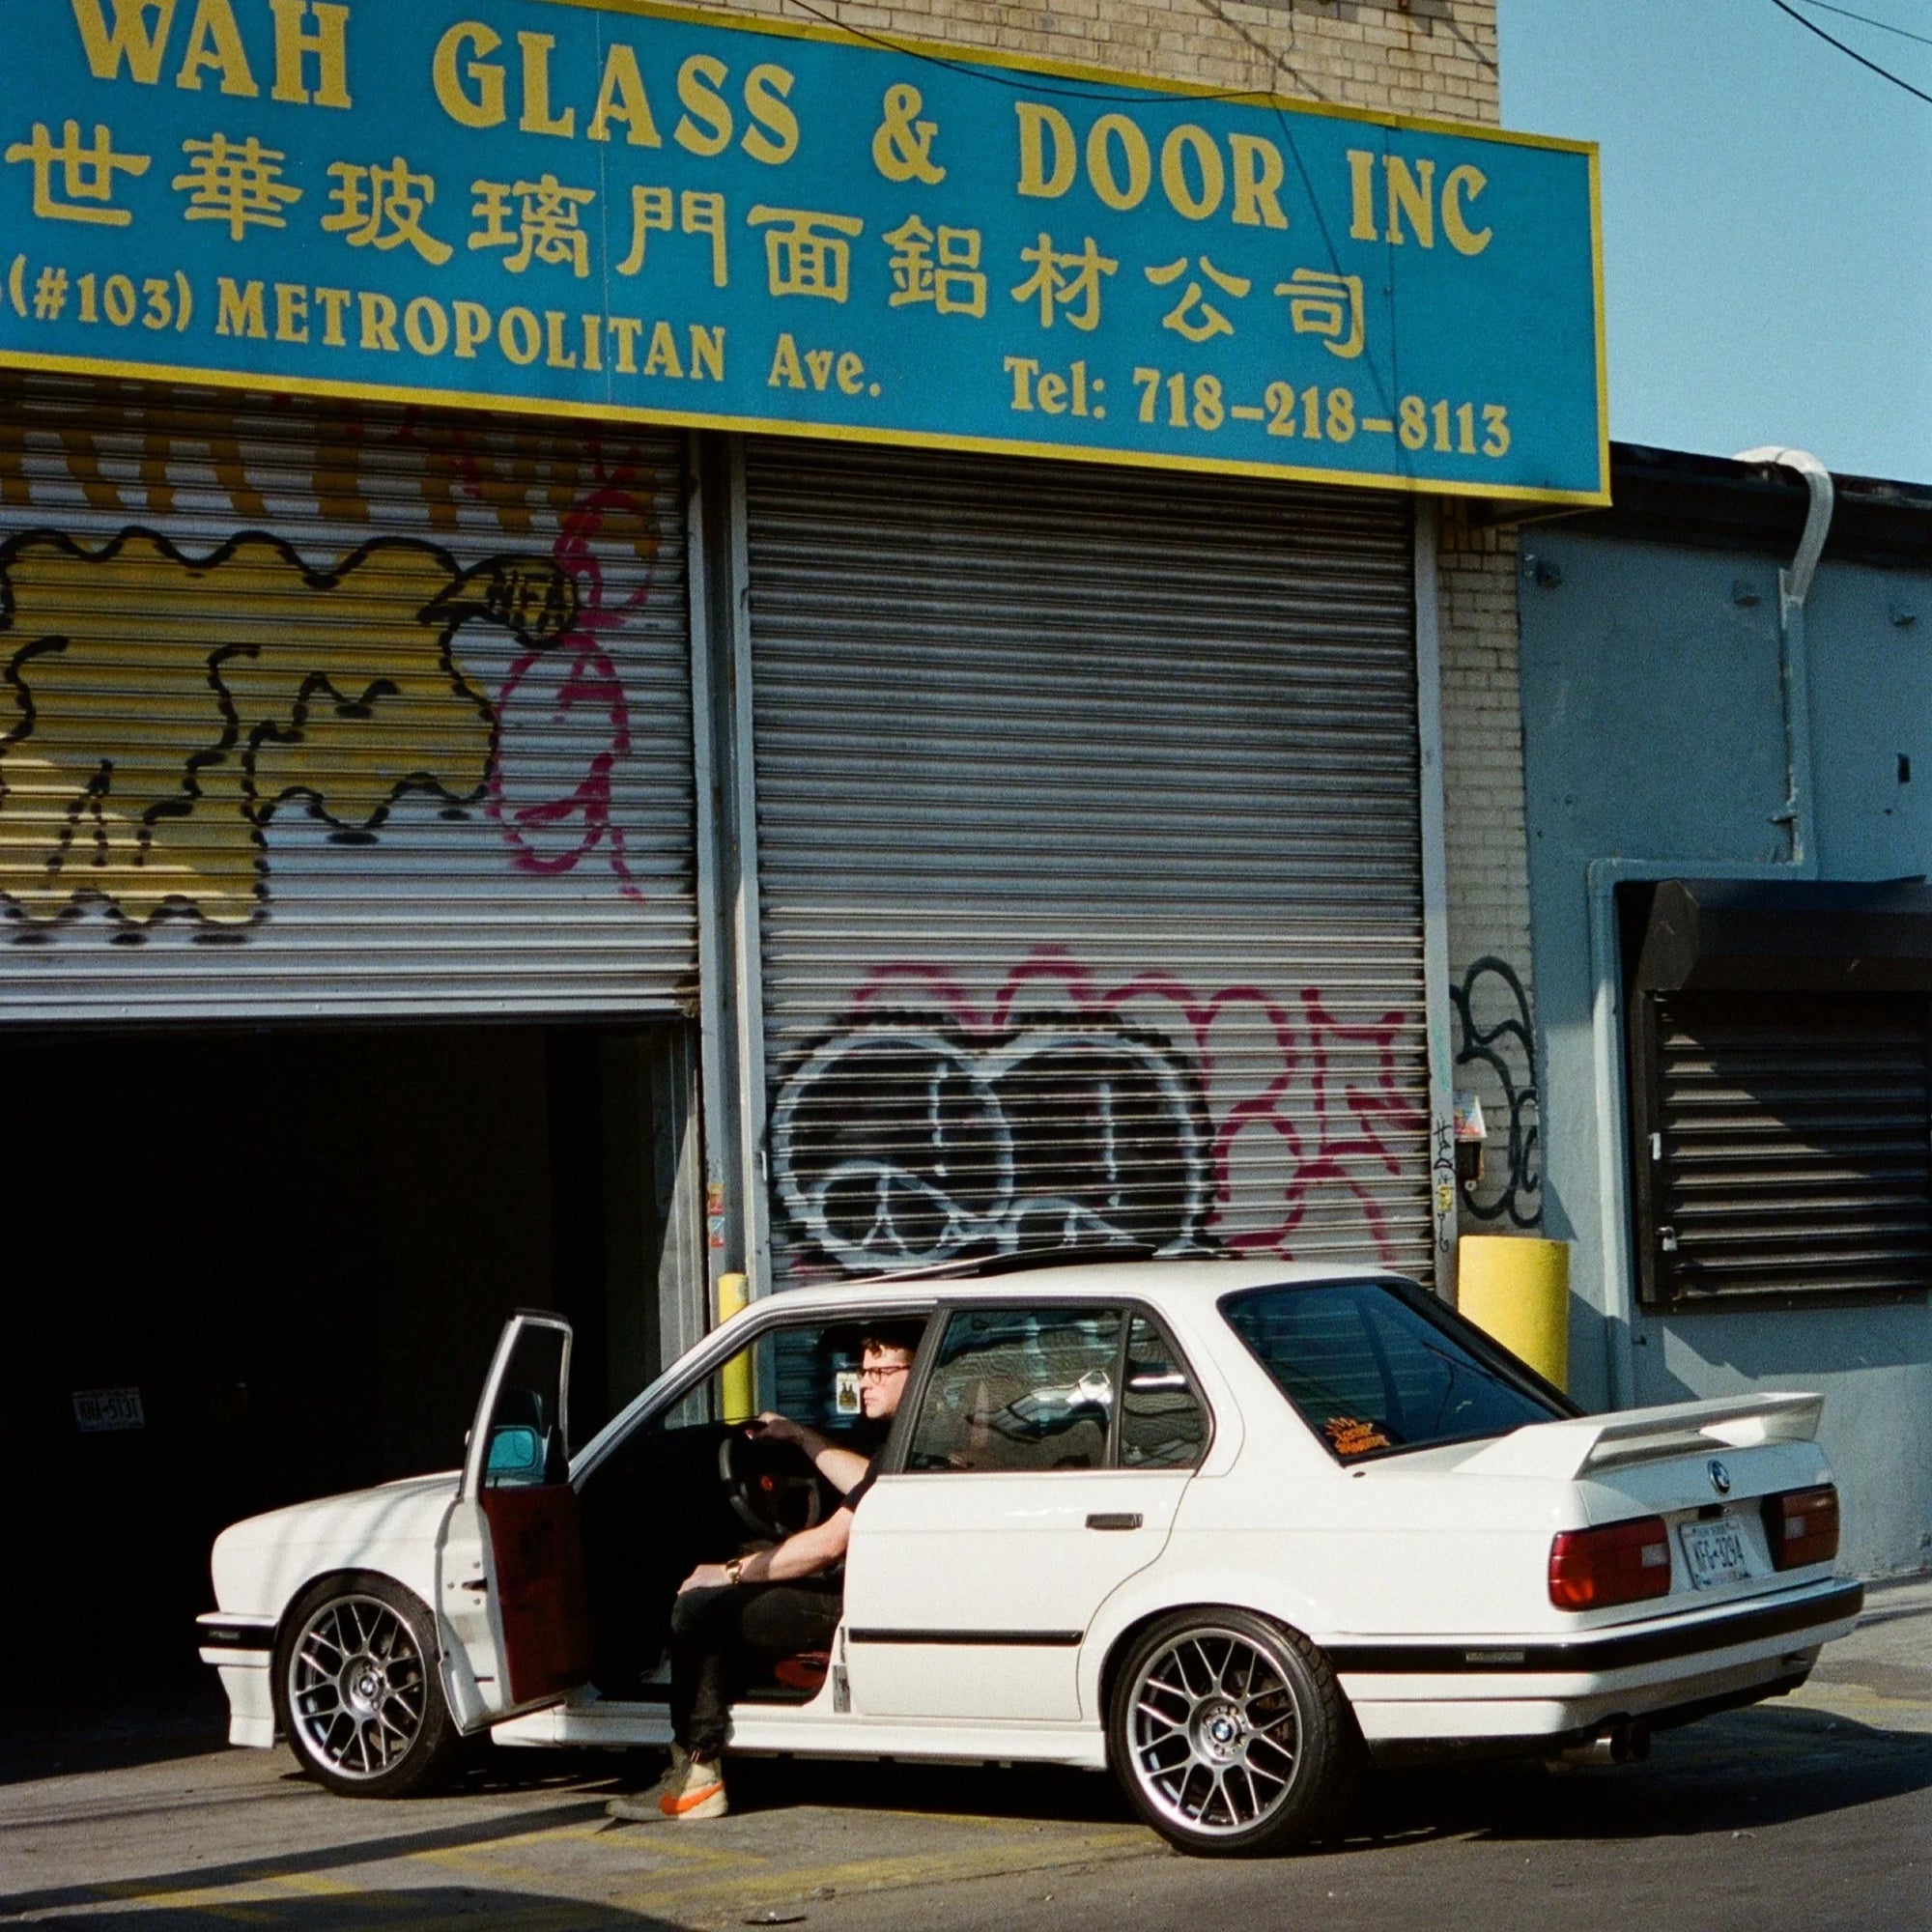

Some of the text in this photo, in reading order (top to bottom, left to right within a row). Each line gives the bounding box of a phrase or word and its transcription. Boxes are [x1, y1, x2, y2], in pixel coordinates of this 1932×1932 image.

[6, 119, 1366, 359] 世華玻璃門面鋁材公司
[71, 0, 1492, 256] WAH GLASS & DOOR INC
[217, 276, 726, 382] METROPOLITAN
[768, 334, 882, 397] Ave.
[1004, 357, 1106, 418] Tel:
[1133, 368, 1511, 457] 718-218-8113
